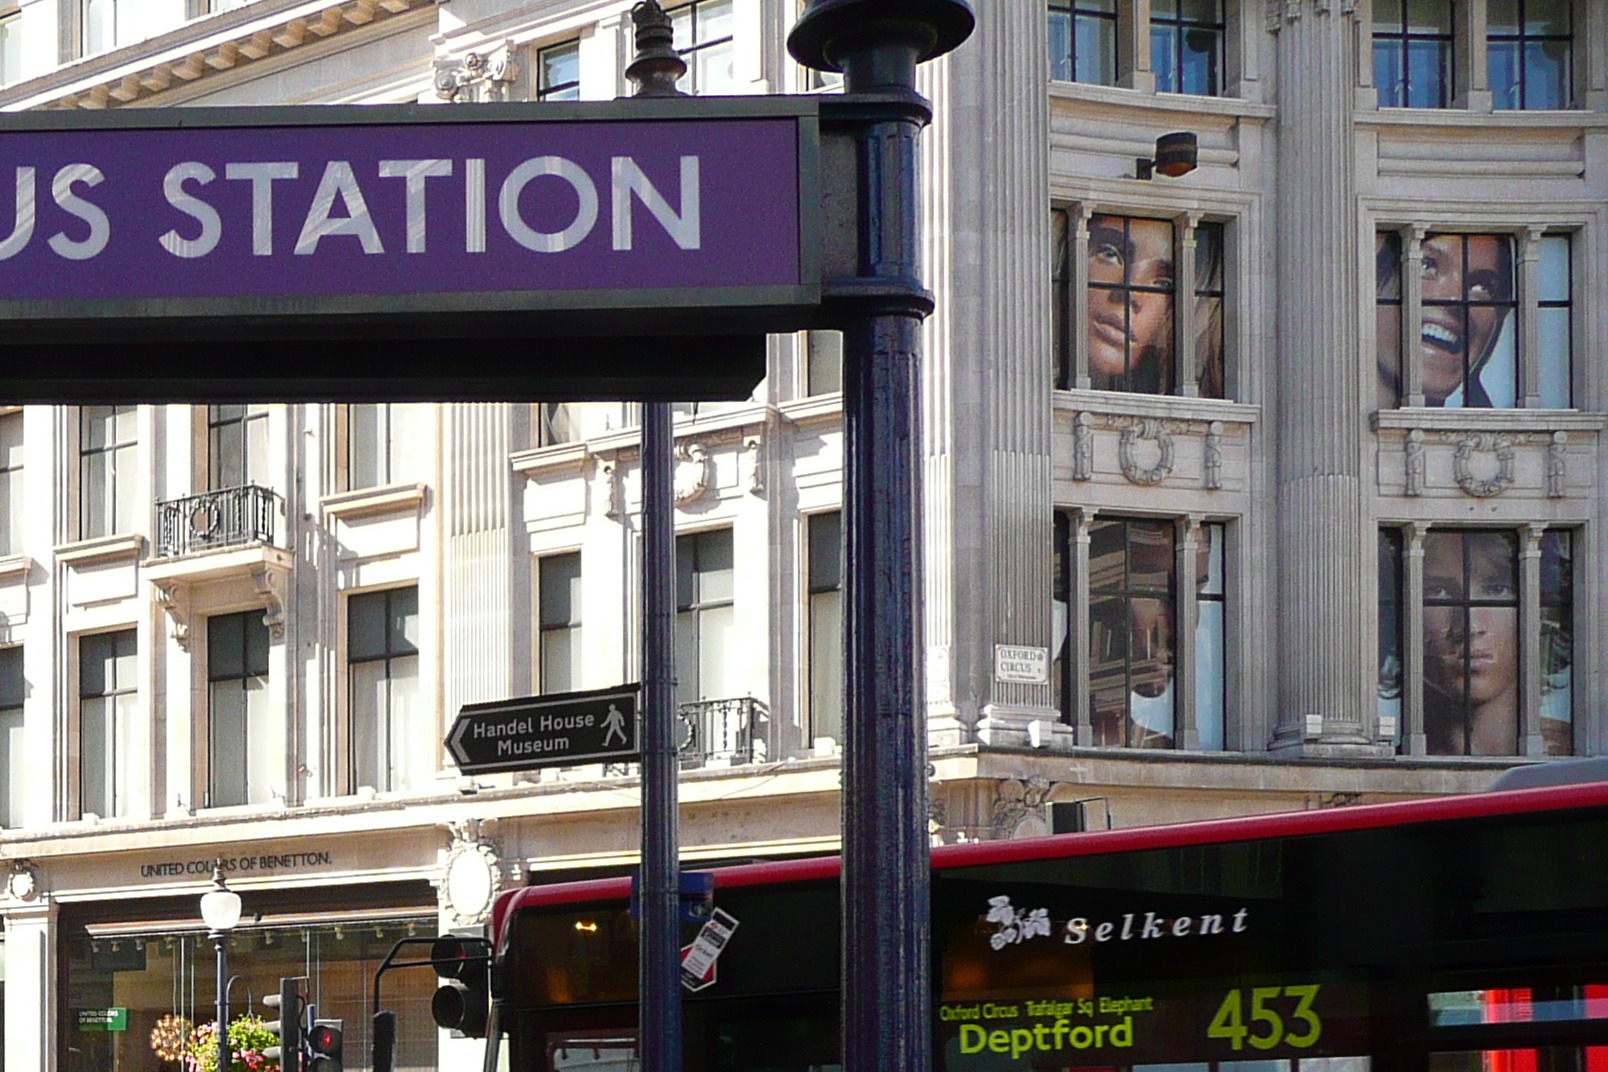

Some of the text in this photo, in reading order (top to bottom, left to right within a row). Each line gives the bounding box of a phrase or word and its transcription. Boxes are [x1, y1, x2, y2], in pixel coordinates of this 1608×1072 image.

[157, 153, 702, 259] STATION
[1000, 650, 1037, 661] OXFORD
[1000, 661, 1032, 673] CIRCUS
[473, 714, 595, 739] Handel House
[497, 736, 570, 757] Museum
[140, 862, 185, 877] UNITED
[186, 858, 237, 874] COLRS
[239, 857, 259, 870] OF
[1065, 908, 1249, 944] Selkent
[940, 997, 1155, 1021] Oxford Circus Trafalgar Sq Elephant
[1206, 984, 1323, 1051] 453
[959, 1016, 1134, 1060] Deptford
